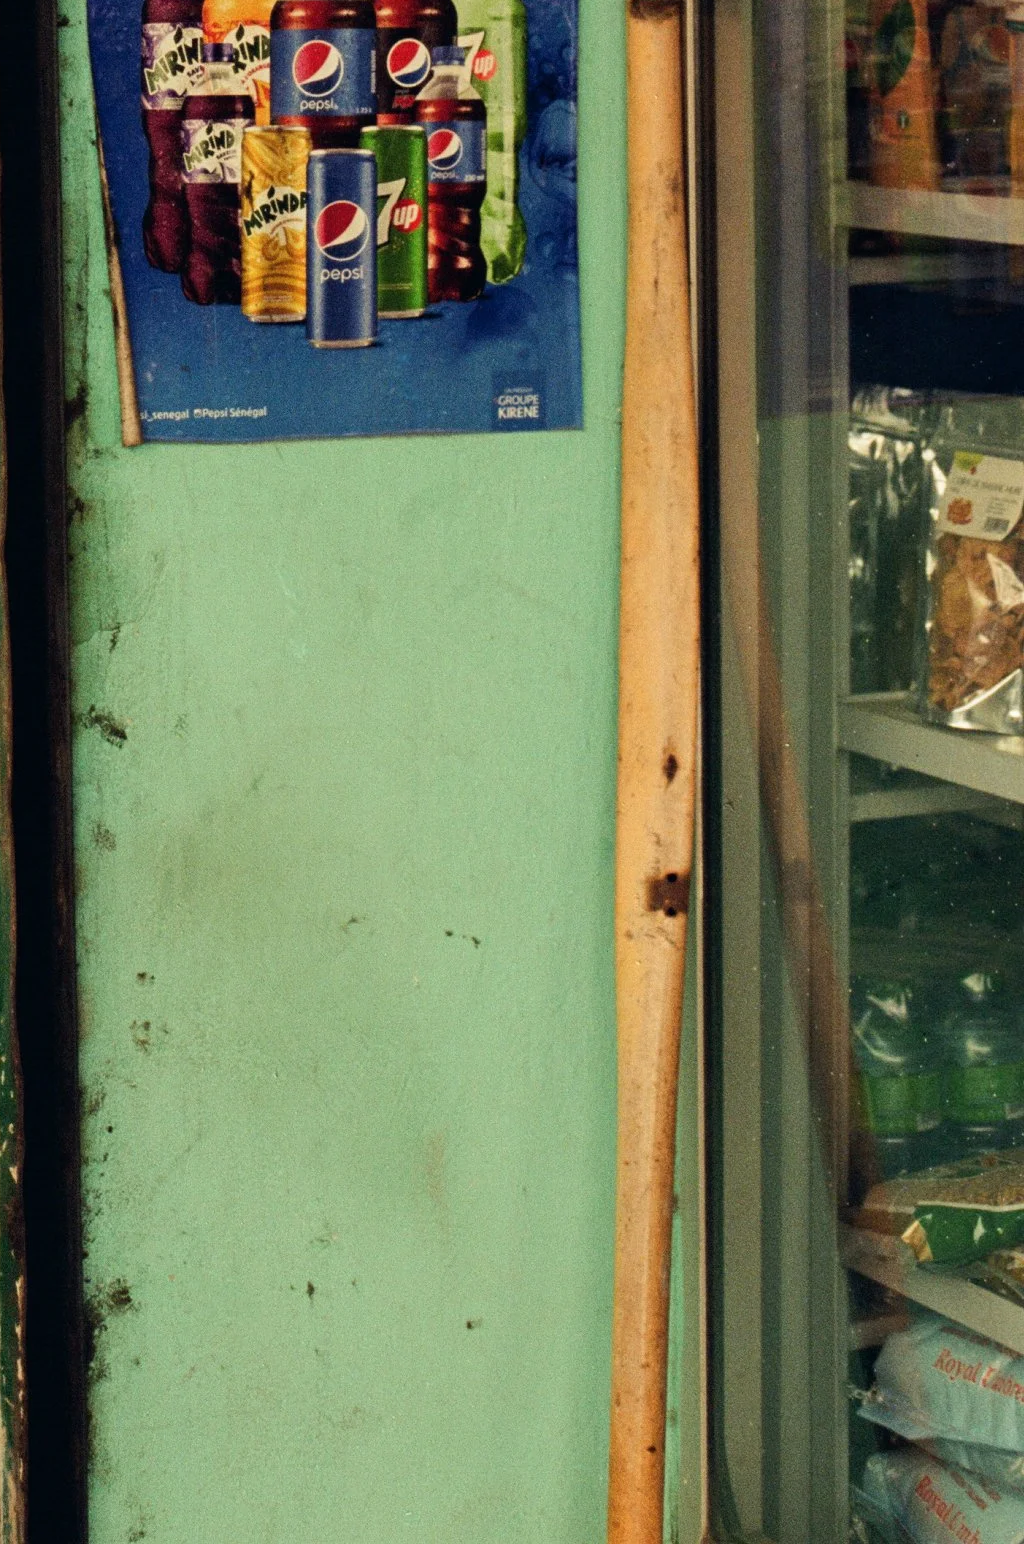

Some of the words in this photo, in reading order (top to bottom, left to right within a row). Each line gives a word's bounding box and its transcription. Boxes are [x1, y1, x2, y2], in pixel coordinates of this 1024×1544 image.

[300, 98, 334, 112] pepsi
[320, 267, 364, 283] pepsi
[498, 394, 539, 406] GROUPE
[140, 408, 189, 421] si_senegal
[203, 408, 227, 419] Pepsi
[230, 406, 267, 419] Sénégal
